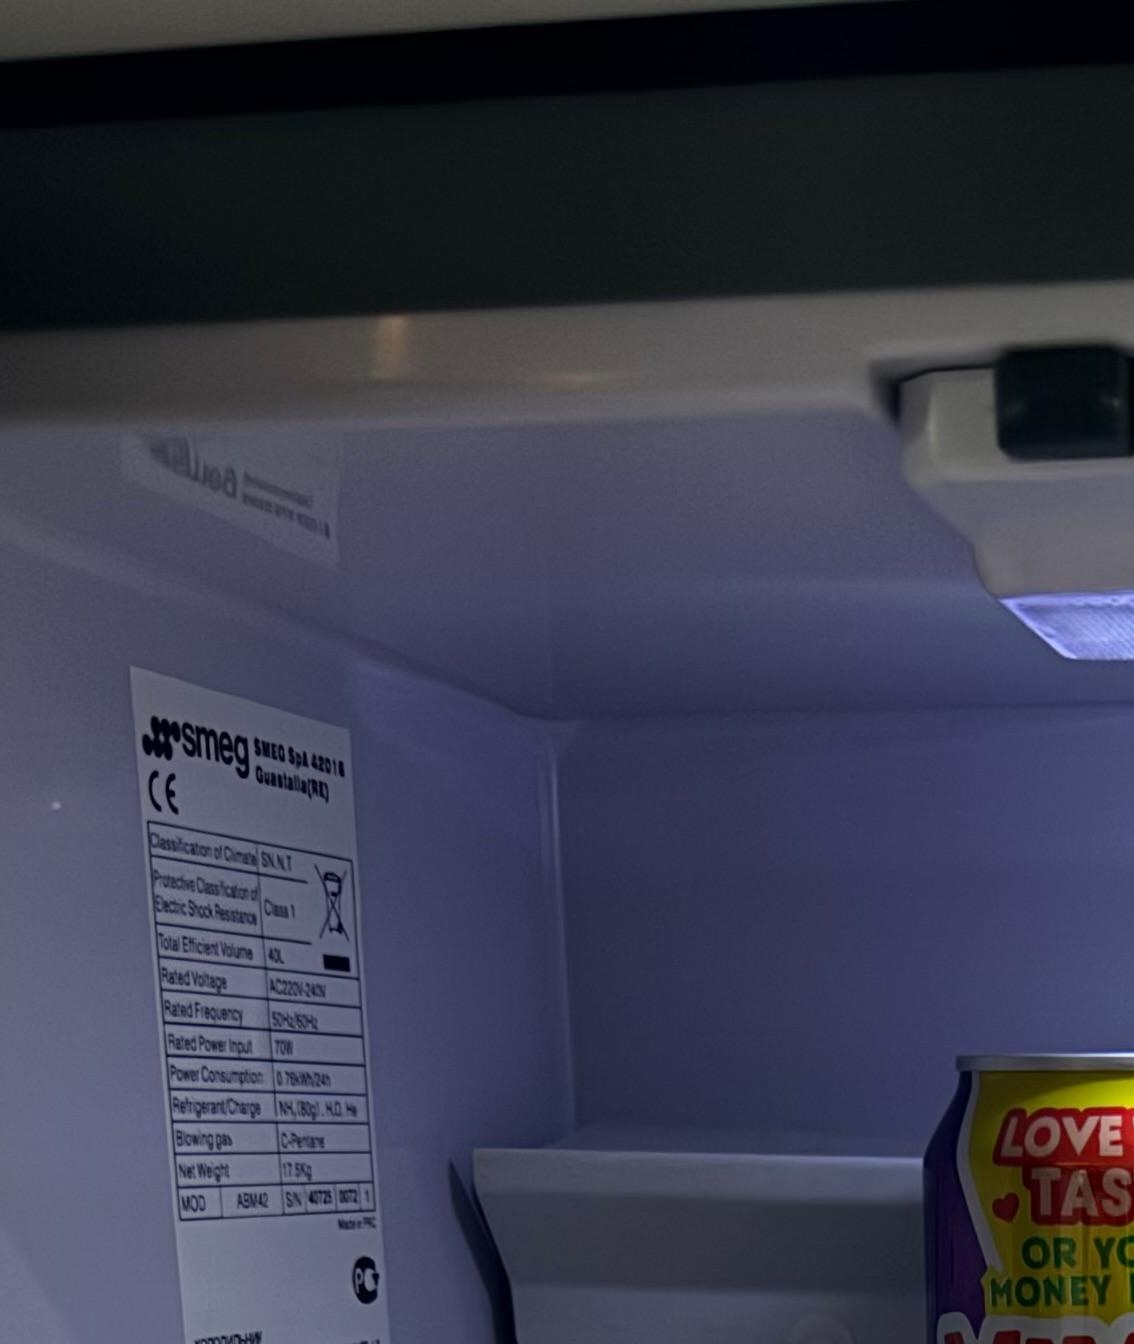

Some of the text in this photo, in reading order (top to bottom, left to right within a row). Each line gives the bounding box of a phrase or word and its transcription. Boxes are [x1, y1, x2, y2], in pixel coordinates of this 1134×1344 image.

[182, 722, 250, 779] smeg
[288, 746, 309, 769] SpA
[151, 831, 258, 867] Classification of Climate
[197, 877, 250, 900] Classification
[155, 895, 257, 926] Electric Shock Resistance
[264, 899, 289, 919] Class
[159, 933, 253, 961] Total Efficient Volume
[161, 967, 228, 995] Rated Voltage
[164, 999, 243, 1026] Rated Frequency
[168, 1033, 253, 1056] Rated Power Input
[170, 1065, 264, 1087] Power Consumption
[173, 1097, 262, 1119] Refrigerant/Charge
[176, 1130, 233, 1151] Blowing gas
[1000, 1115, 1124, 1158] LOVE
[178, 1162, 230, 1182] Net Weight
[181, 1195, 206, 1212] MOD
[1021, 1237, 1078, 1269] OR
[990, 1275, 1112, 1308] MONEY
